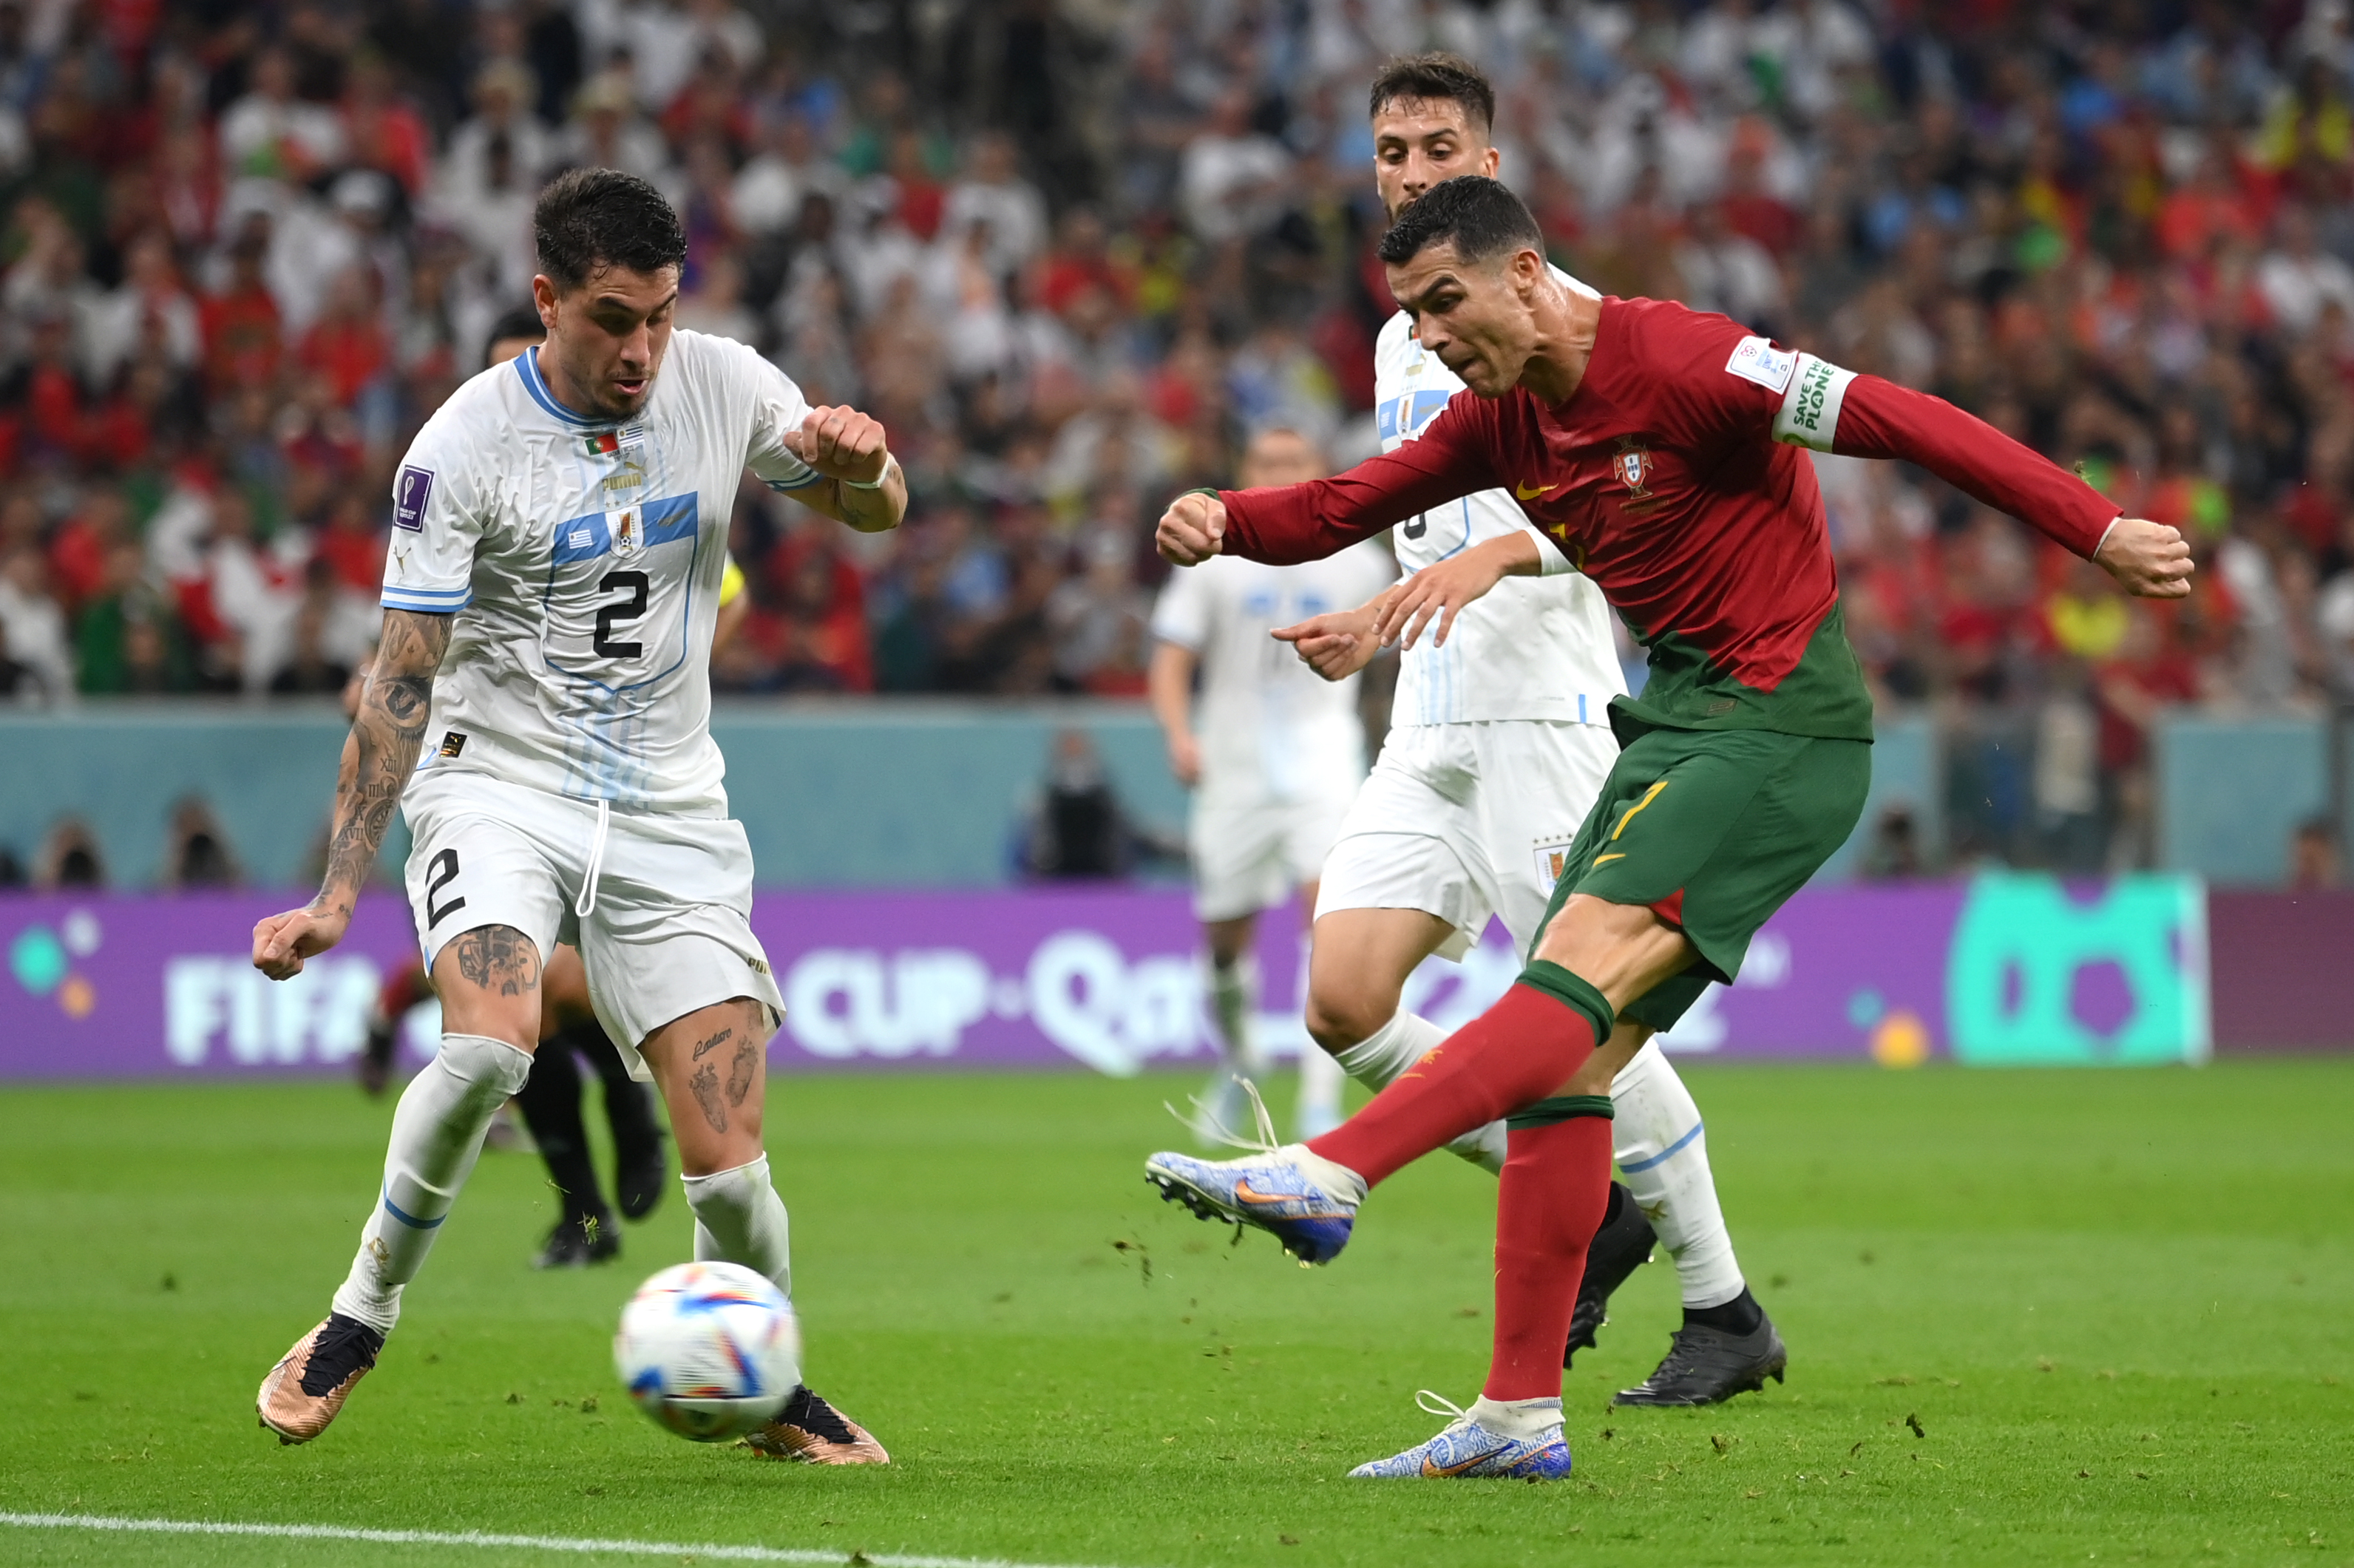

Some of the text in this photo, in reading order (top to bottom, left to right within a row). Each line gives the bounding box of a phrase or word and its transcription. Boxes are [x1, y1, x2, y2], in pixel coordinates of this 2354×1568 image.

[1794, 383, 1812, 426] SAVE
[1805, 363, 1837, 431] PLANE
[593, 571, 649, 658] 2
[425, 848, 466, 931] 2
[165, 952, 386, 1065] FIFA
[787, 950, 989, 1057] CUP
